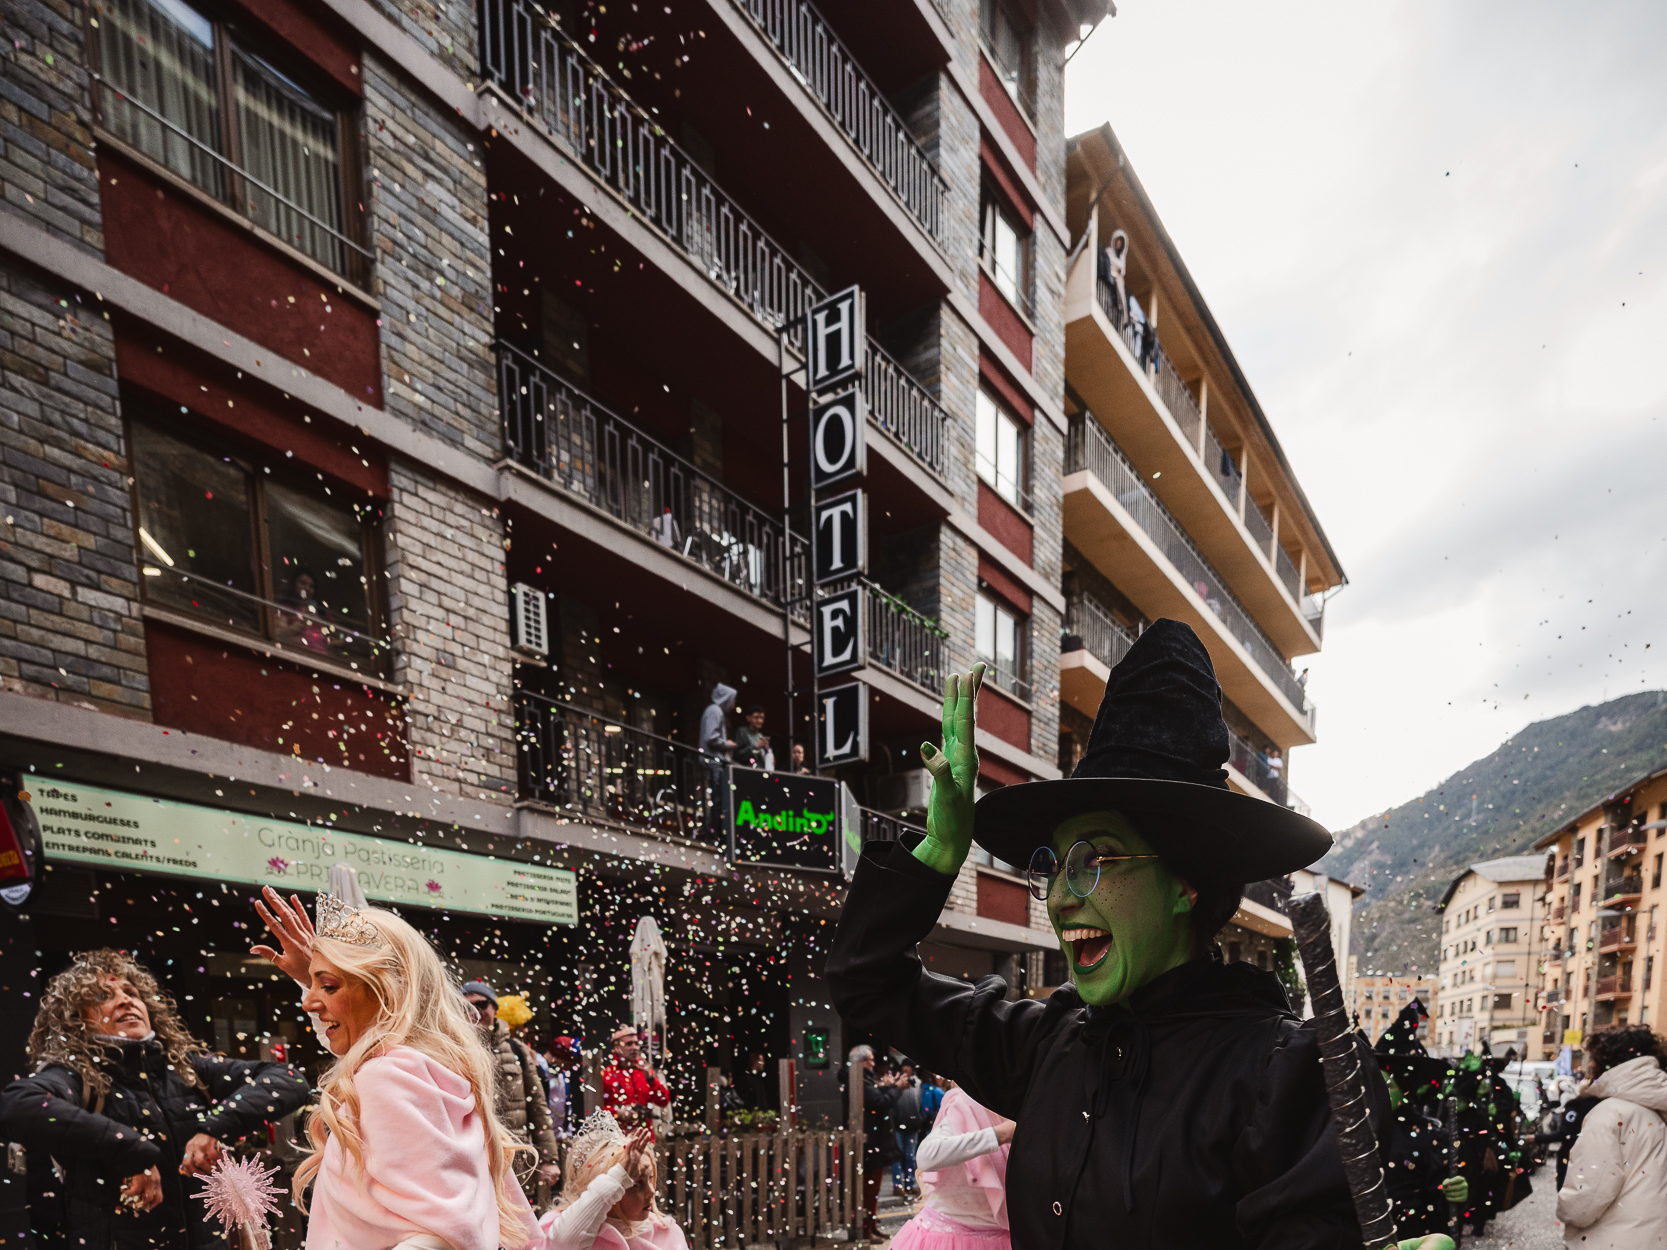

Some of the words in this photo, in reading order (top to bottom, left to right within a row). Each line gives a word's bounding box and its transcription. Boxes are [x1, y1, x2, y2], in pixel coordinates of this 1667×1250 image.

[814, 299, 855, 760] HOTEL
[38, 788, 78, 802] TAPES
[39, 806, 140, 828] HAMBURGUESES
[736, 800, 835, 835] Andino
[42, 824, 81, 838] PLATS
[45, 841, 112, 857] ENTREPANS
[344, 841, 444, 874] Pastisseria
[297, 862, 419, 893] PRIAVERA
